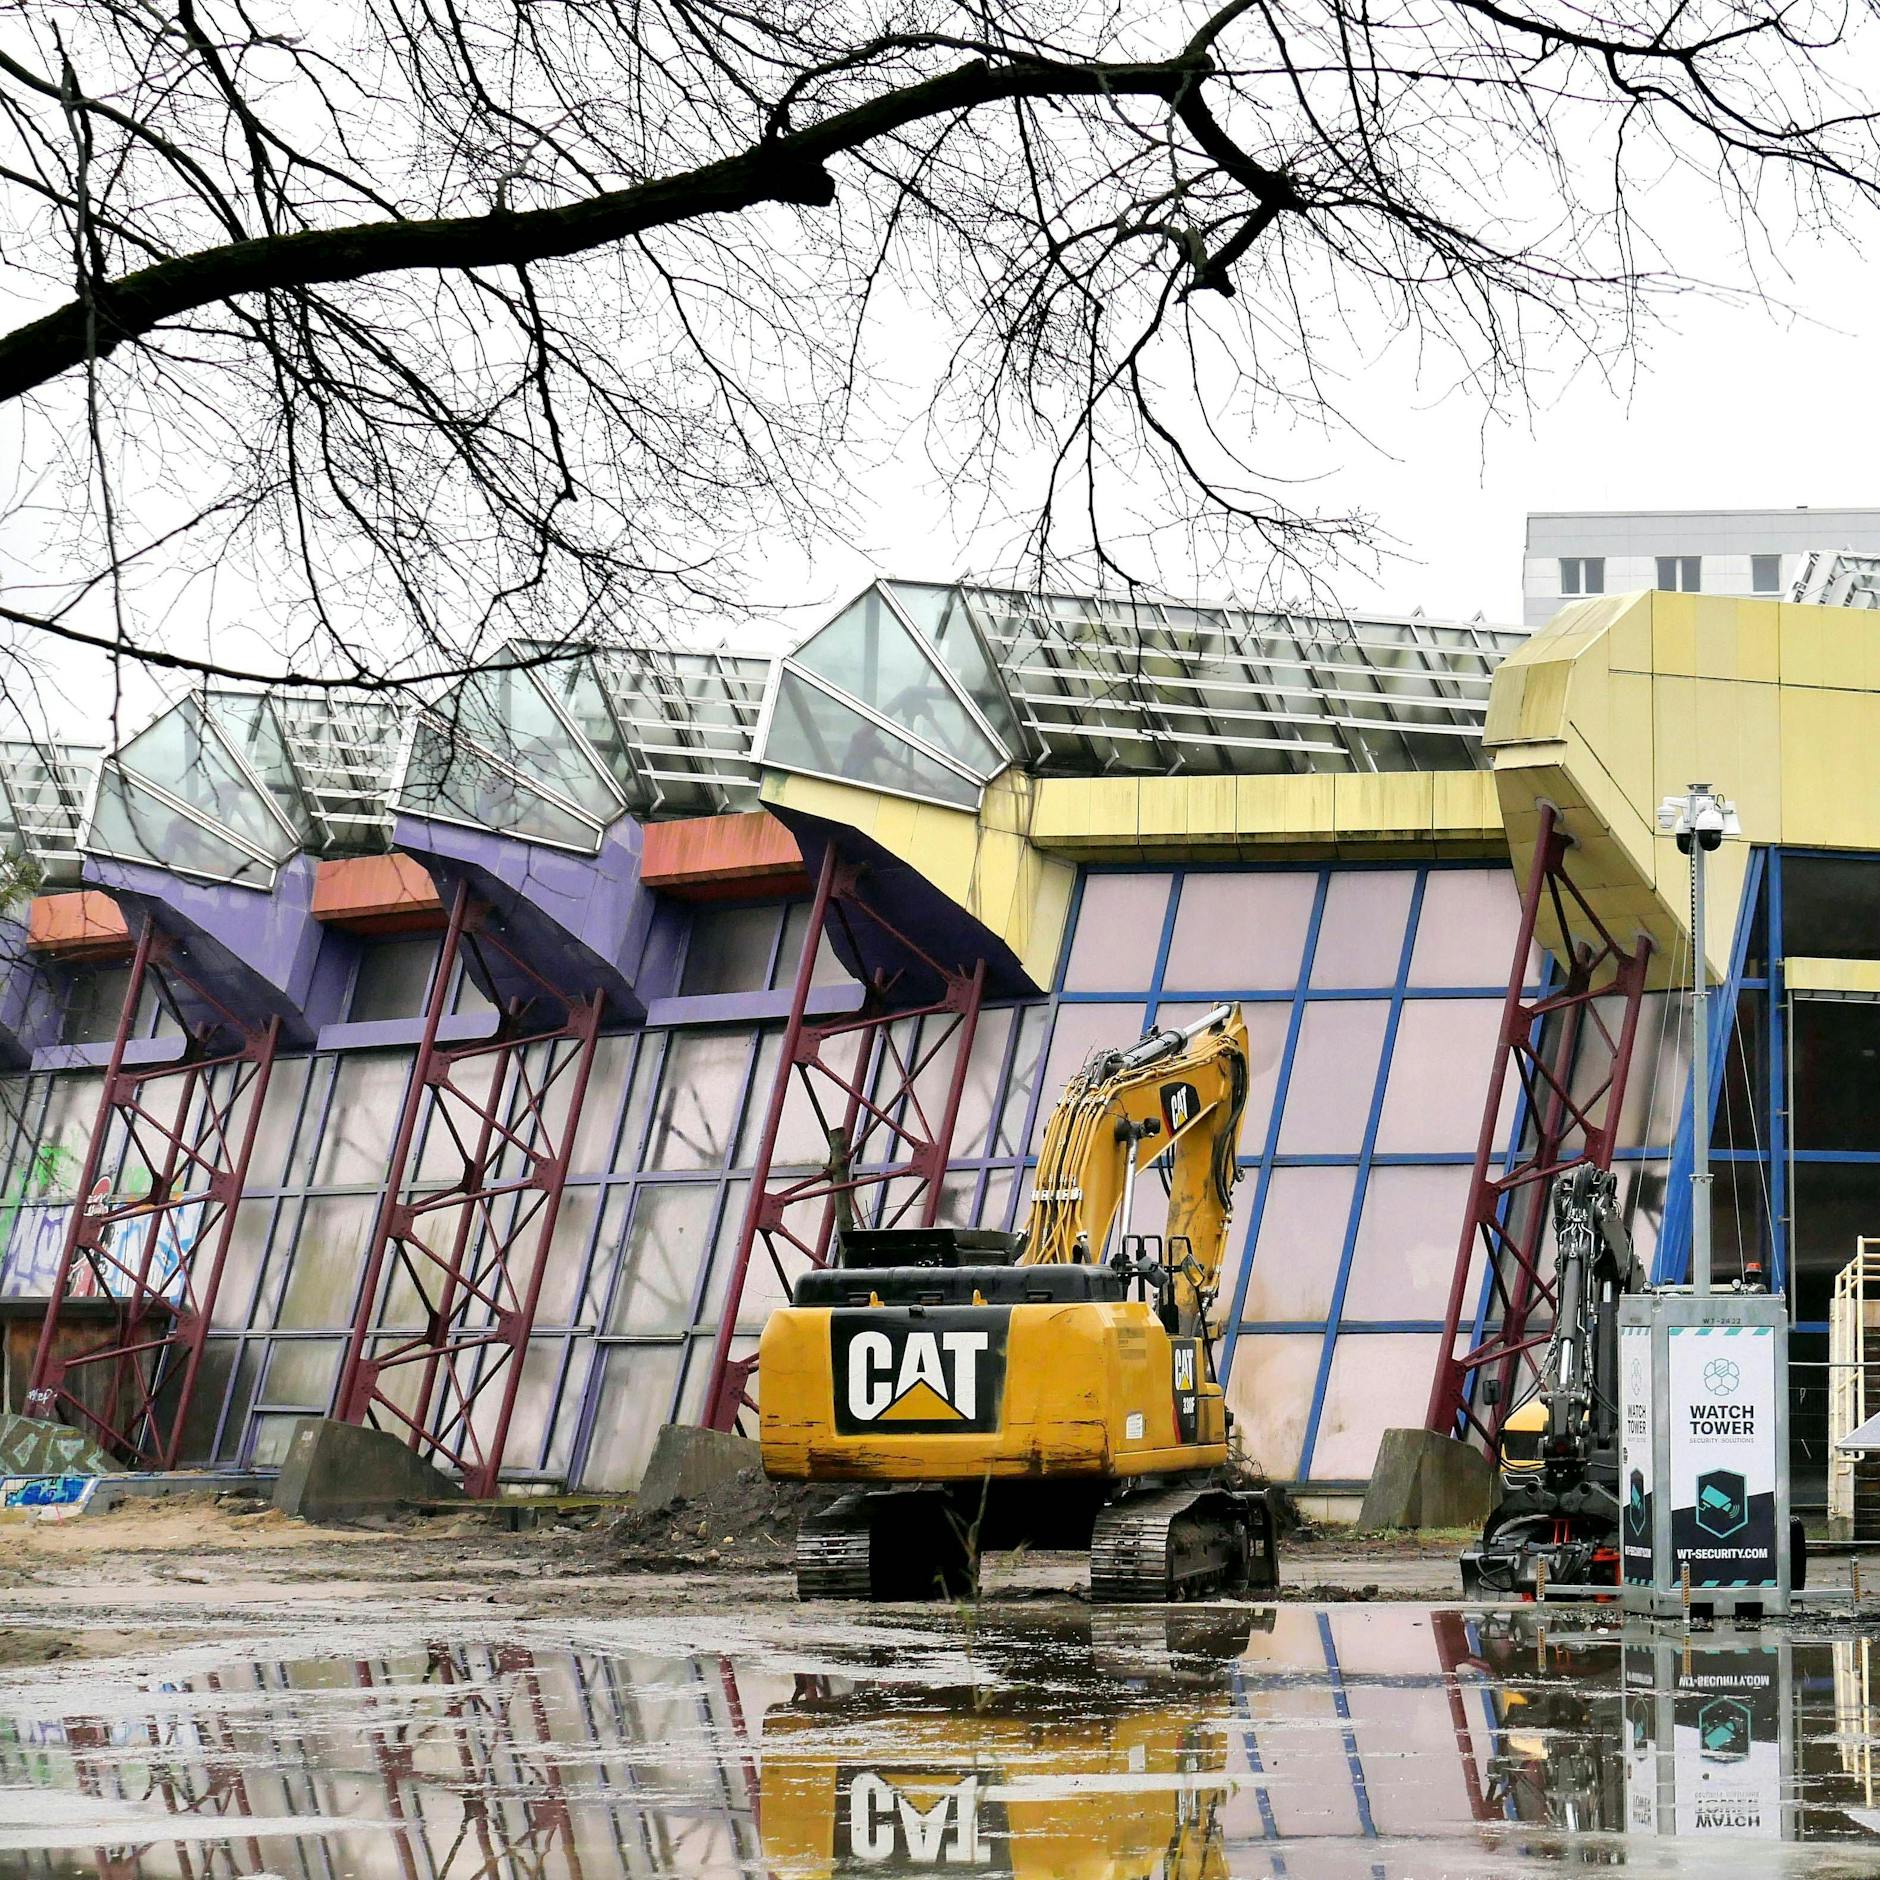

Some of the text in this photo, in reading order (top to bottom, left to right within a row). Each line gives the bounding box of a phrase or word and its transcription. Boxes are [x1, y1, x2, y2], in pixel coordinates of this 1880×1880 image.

[1171, 1085, 1189, 1130] CAT
[848, 1331, 989, 1421] CAT
[1174, 1348, 1194, 1391] CAT
[1627, 1404, 1647, 1419] WATCH
[1689, 1405, 1755, 1419] WATCH
[1627, 1420, 1647, 1435] TOWER
[1689, 1421, 1755, 1435] TOWER
[1677, 1548, 1768, 1559] WT-SECURITY.COM
